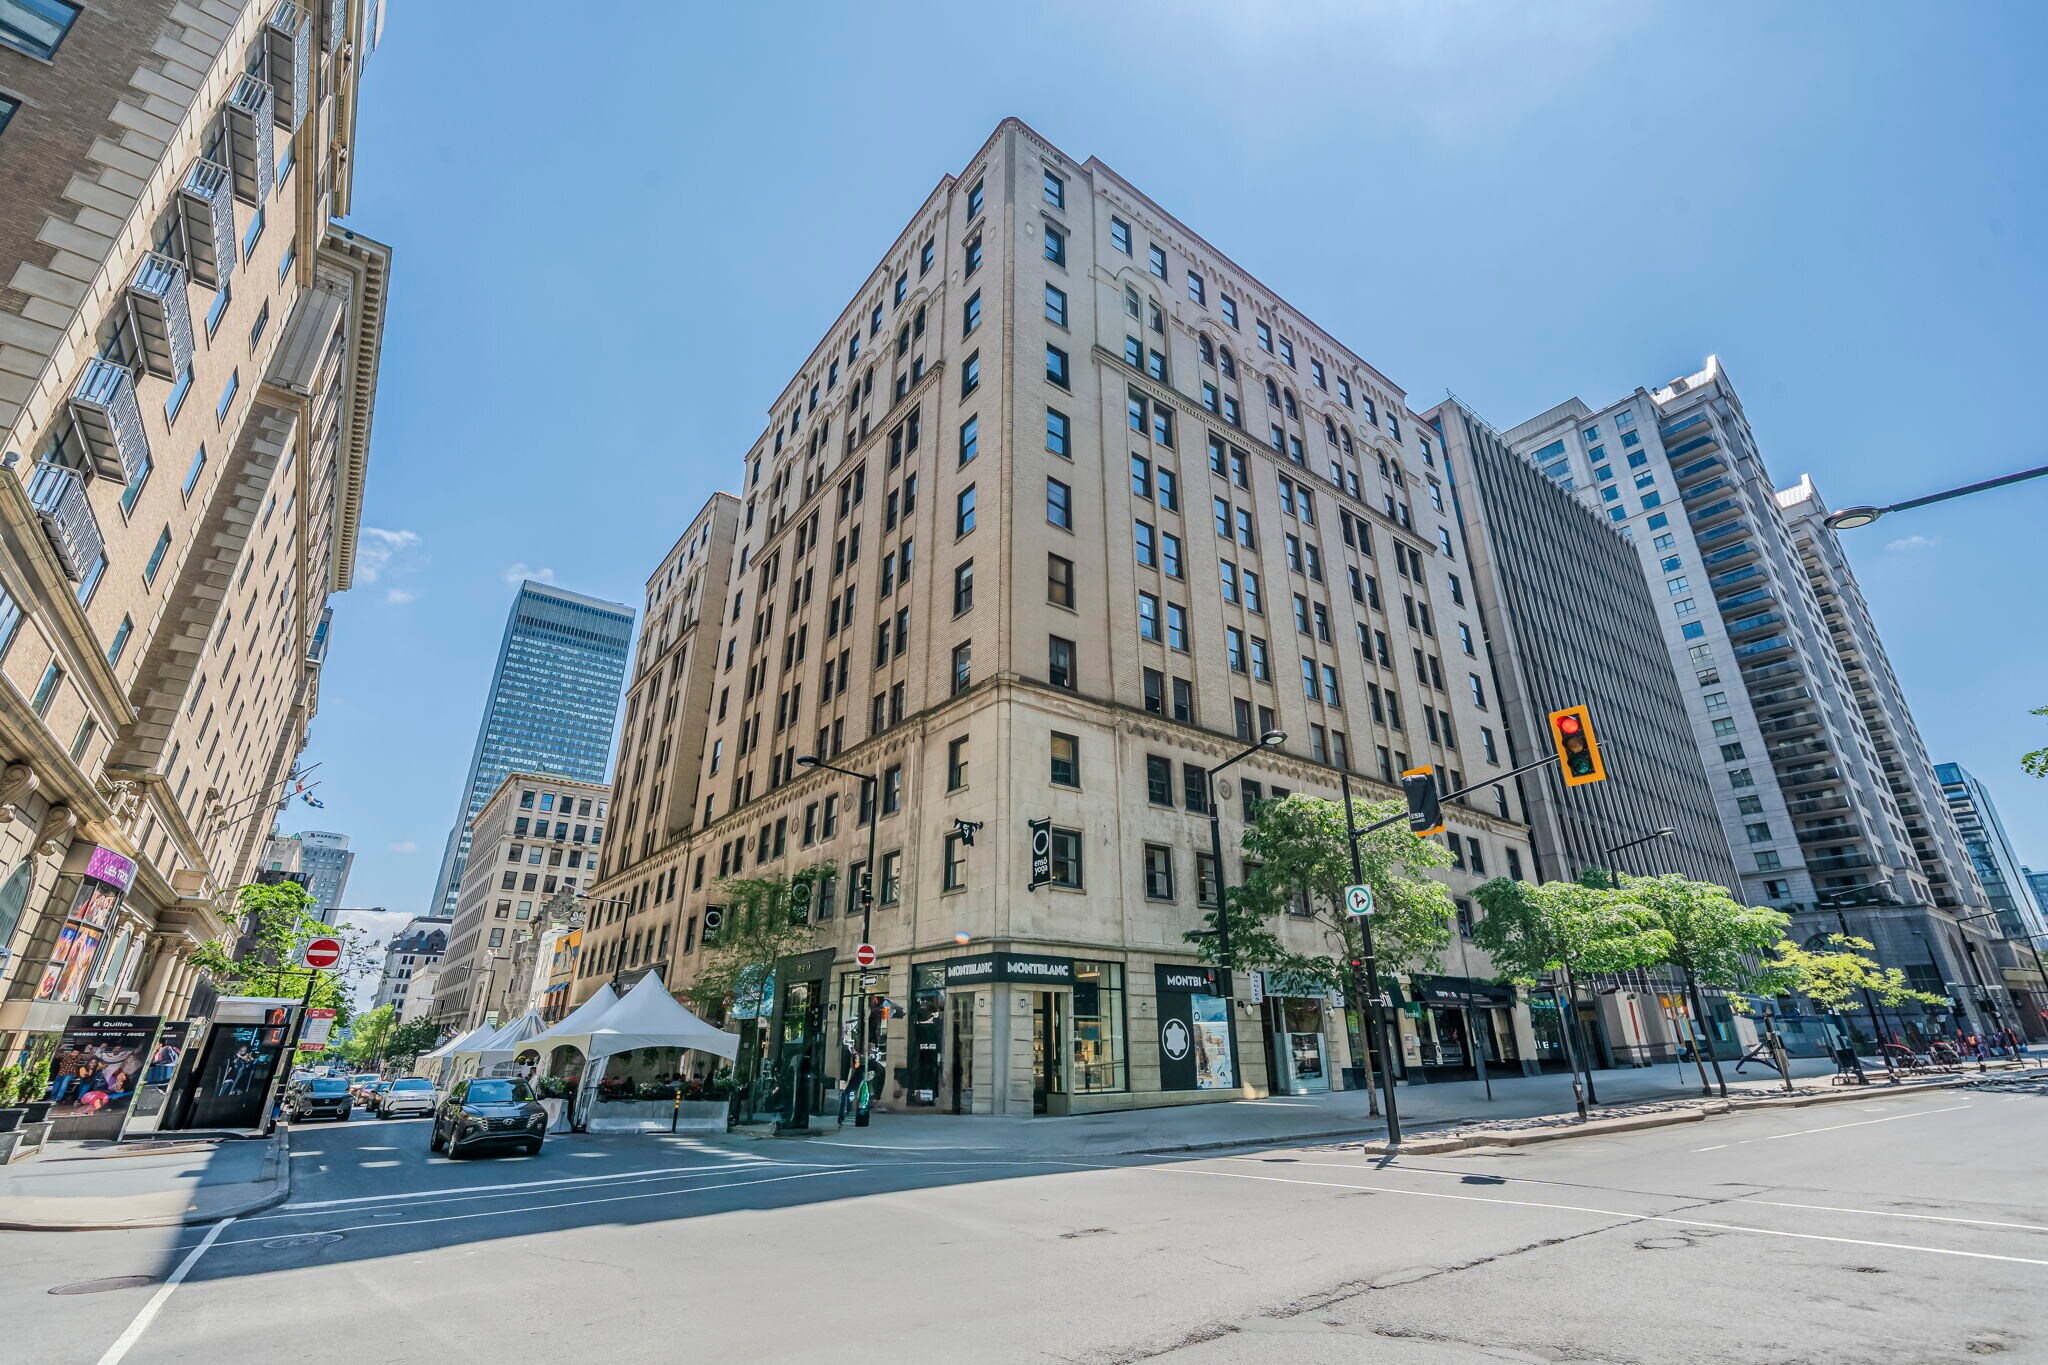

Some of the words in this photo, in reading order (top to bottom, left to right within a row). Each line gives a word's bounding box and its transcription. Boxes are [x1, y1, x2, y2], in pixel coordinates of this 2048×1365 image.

[1034, 864, 1048, 877] yoga
[948, 962, 993, 977] MONTBLANC
[1007, 962, 1069, 976] MONTBLANC
